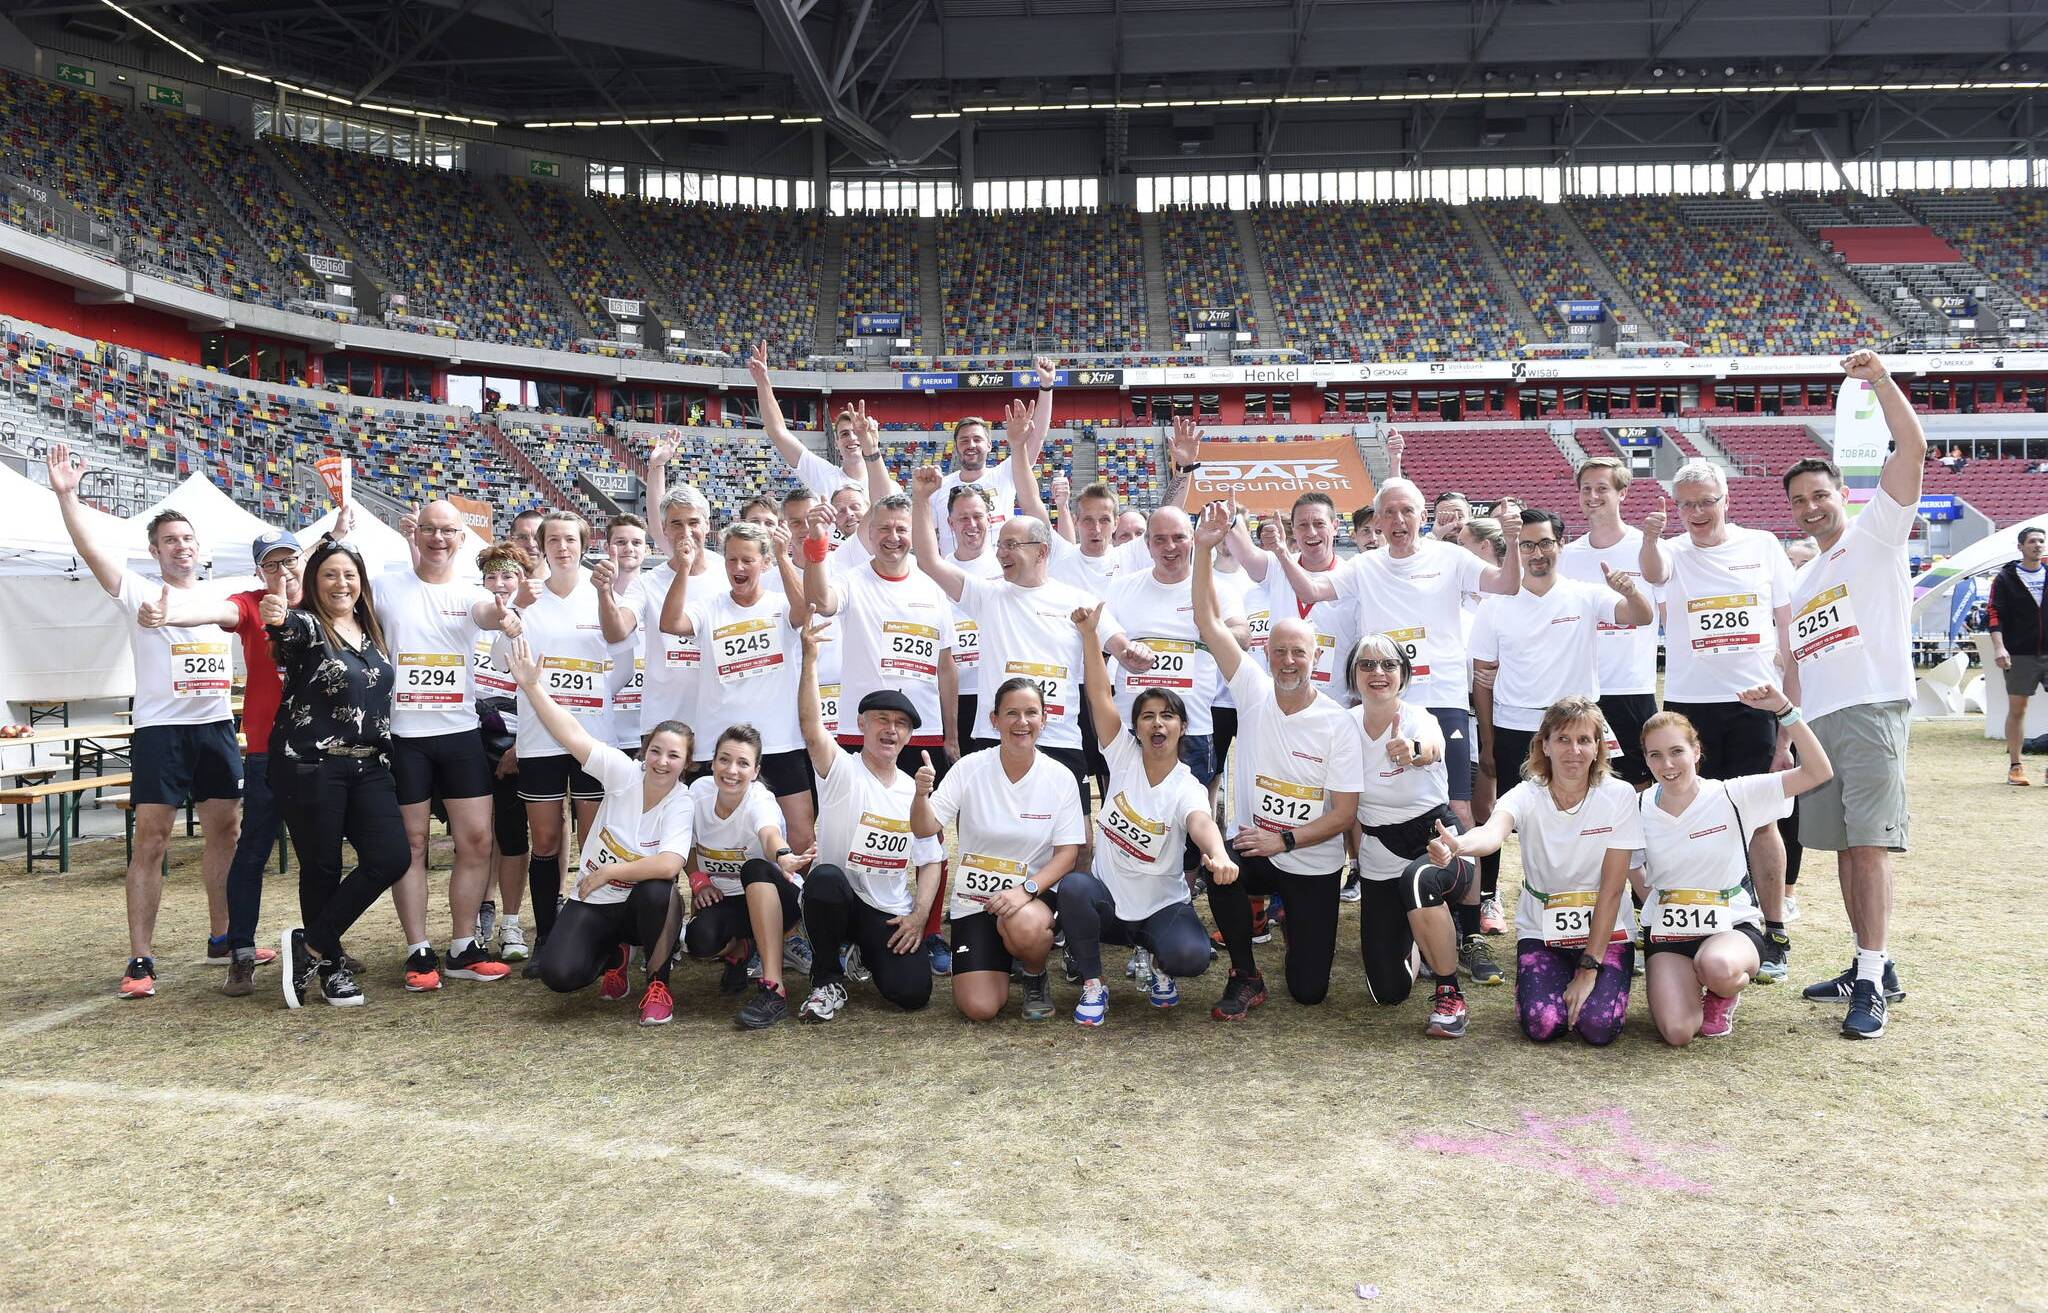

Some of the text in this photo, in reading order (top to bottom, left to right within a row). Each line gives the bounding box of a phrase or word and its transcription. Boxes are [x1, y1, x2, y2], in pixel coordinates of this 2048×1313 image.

[32, 189, 47, 203] 158
[313, 258, 343, 272] 159 160
[612, 301, 638, 313] 161 162
[1571, 325, 1586, 334] 103
[1245, 367, 1299, 382] Henkel
[1840, 449, 1877, 459] JOBRAD
[1193, 459, 1346, 480] DAK
[1195, 478, 1352, 492] Gesundheit
[1918, 500, 1952, 508] MERKUR
[1700, 610, 1750, 631] 5286
[1798, 605, 1840, 638] 5251
[724, 633, 771, 657] 5245
[892, 636, 933, 658] 5258
[958, 633, 979, 648] 52
[184, 657, 225, 674] 5284
[408, 669, 456, 686] 5294
[550, 672, 592, 690] 5291
[1261, 794, 1311, 820] 5312
[1108, 810, 1152, 849] 5252
[865, 831, 908, 852] 5300
[966, 872, 1014, 894] 5326
[1662, 908, 1719, 929] 5314
